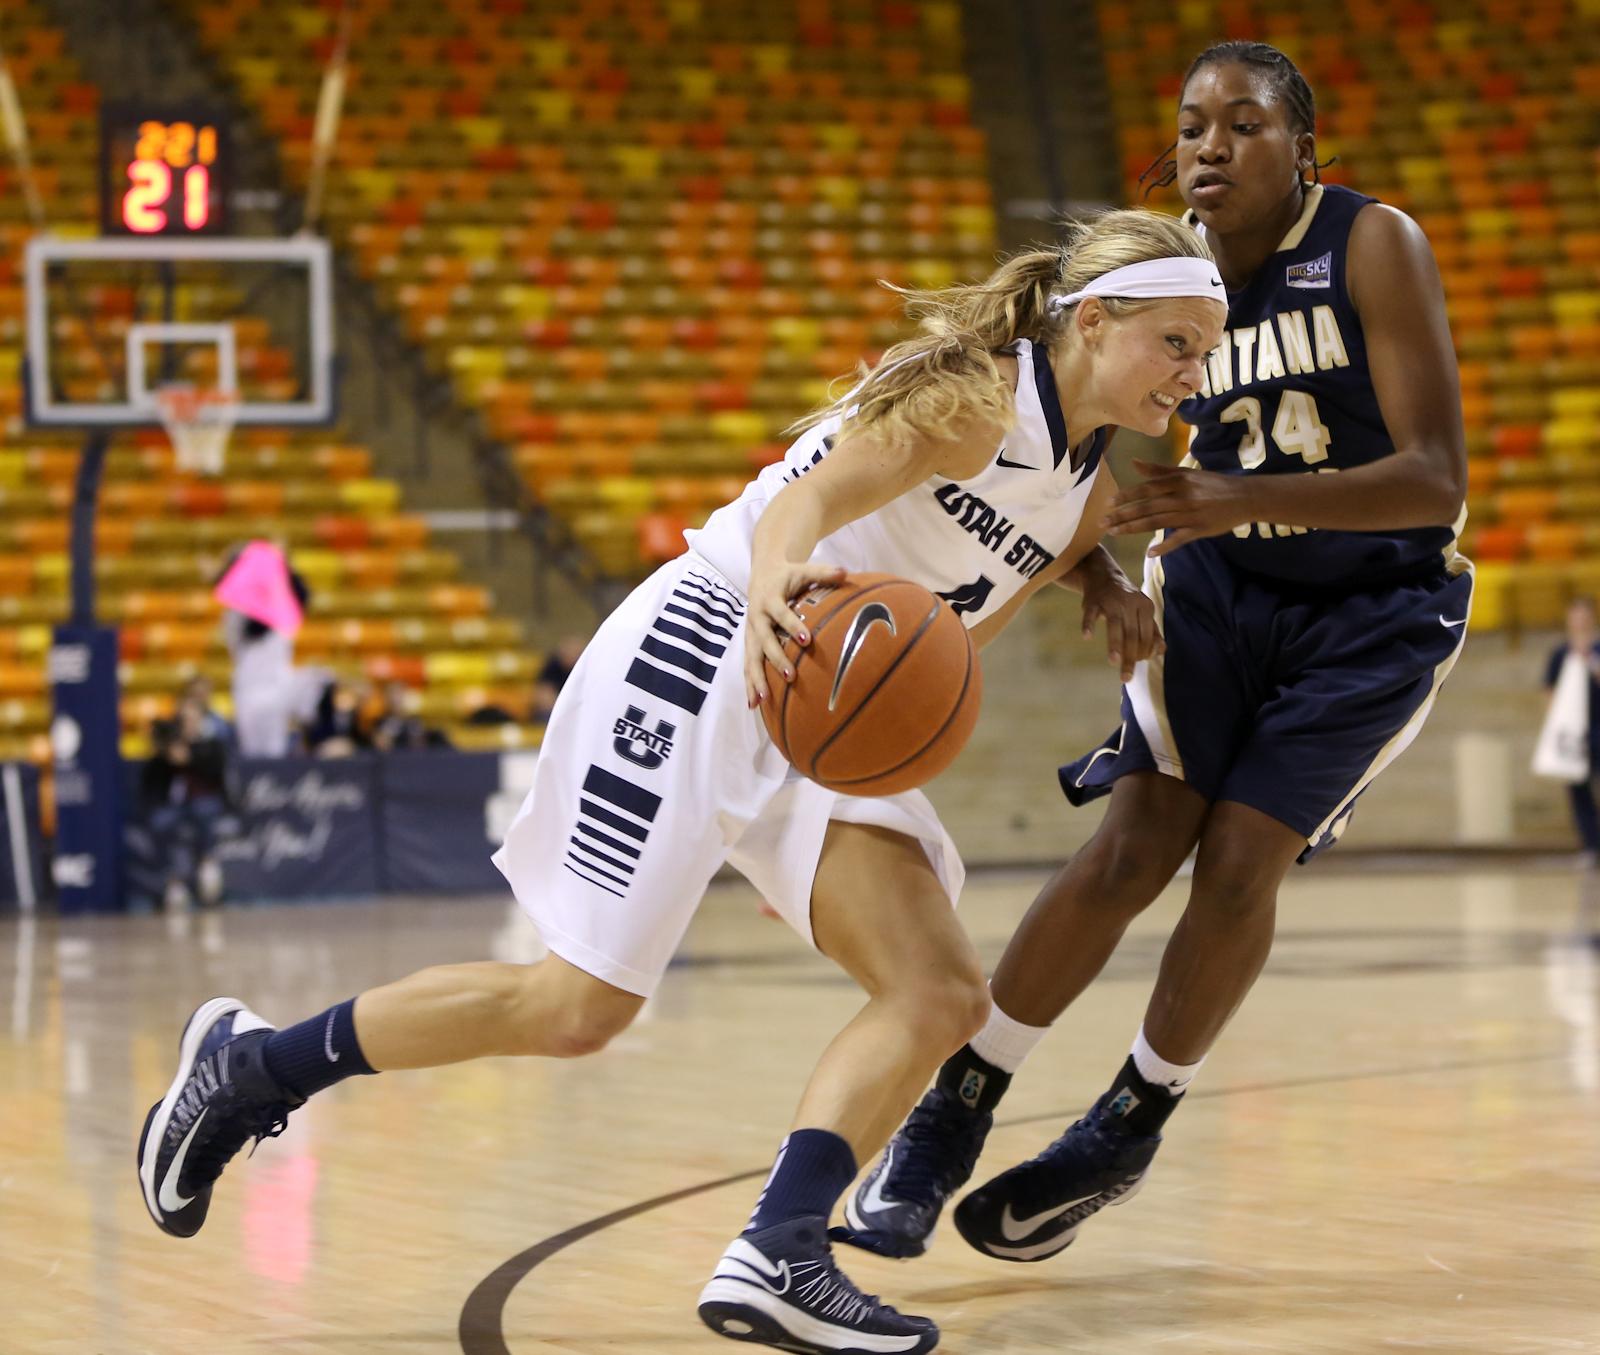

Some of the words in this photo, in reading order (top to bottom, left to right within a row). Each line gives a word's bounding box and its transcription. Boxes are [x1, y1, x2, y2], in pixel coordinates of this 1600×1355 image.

[122, 160, 209, 233] 21
[1220, 389, 1332, 469] 34
[934, 483, 1015, 553] UTAH
[613, 718, 674, 760] STATE
